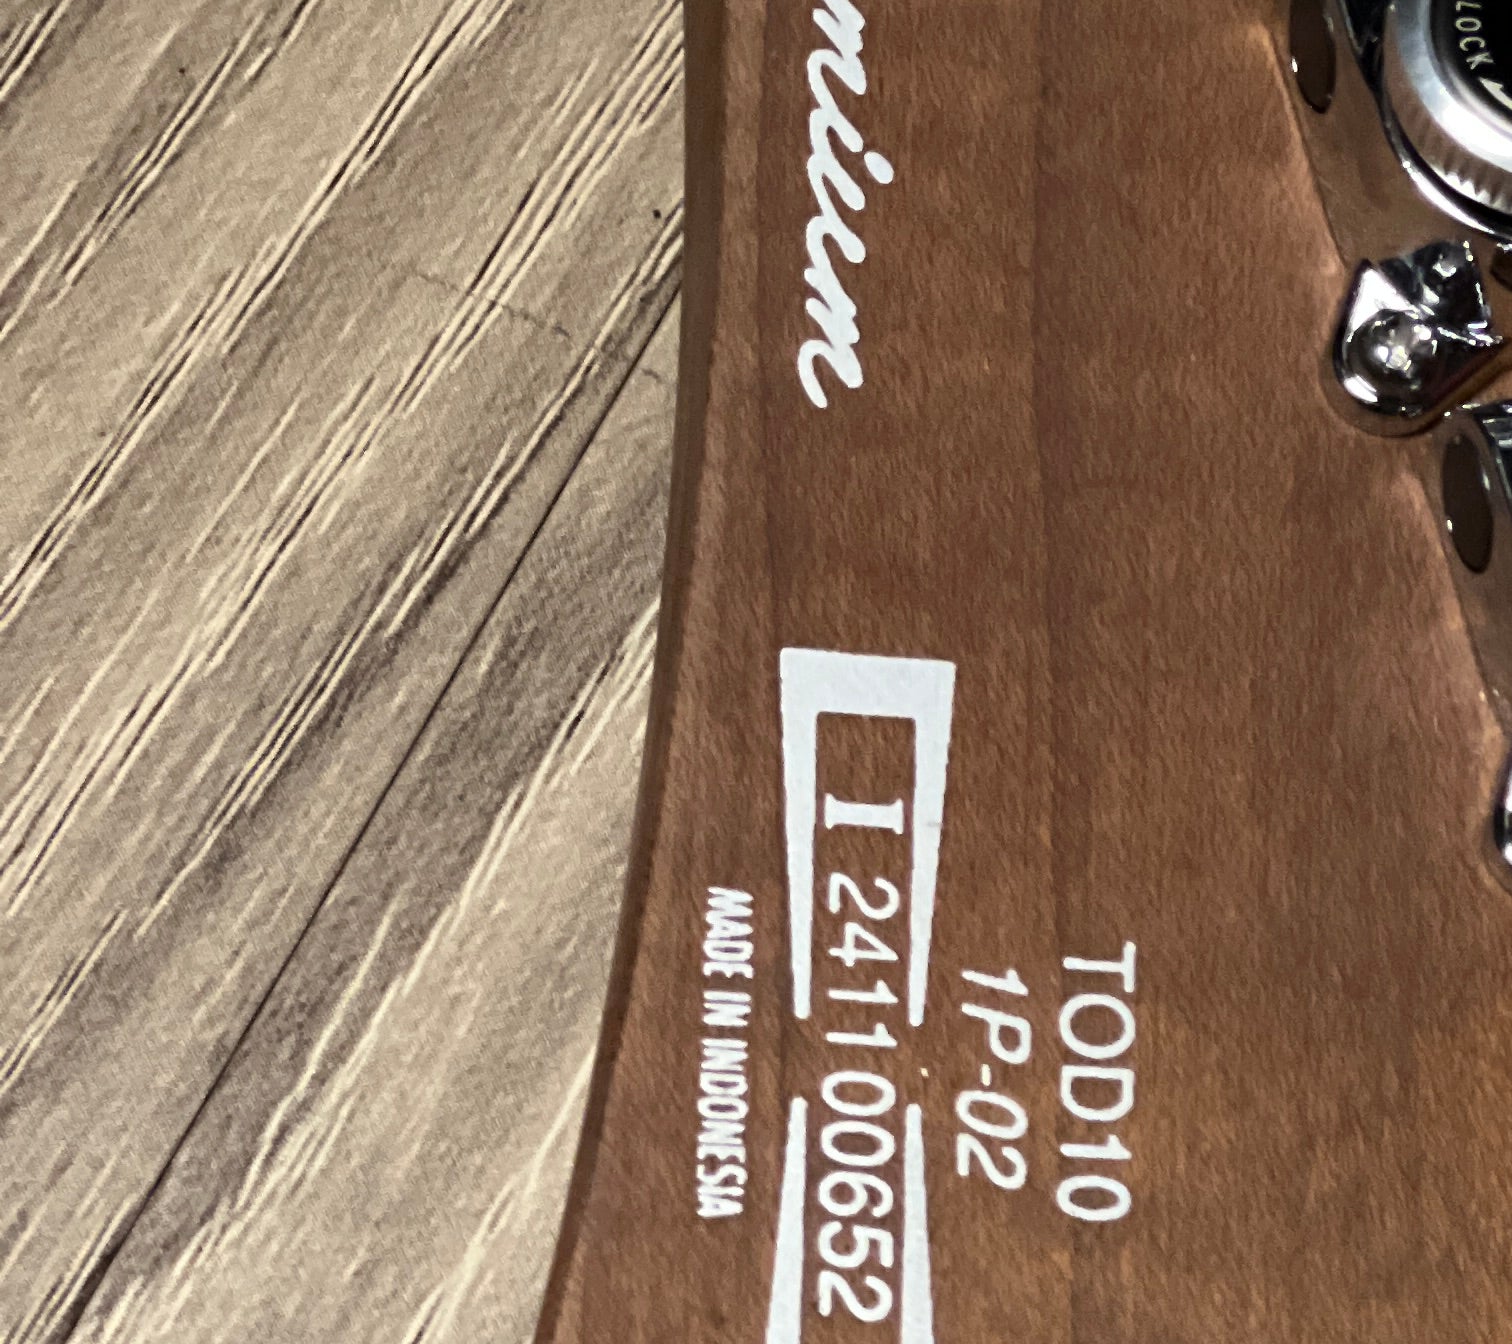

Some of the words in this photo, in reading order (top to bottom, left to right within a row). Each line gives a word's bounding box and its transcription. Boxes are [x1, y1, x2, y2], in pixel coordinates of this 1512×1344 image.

[1455, 0, 1495, 70] LOCK
[702, 885, 755, 981] MADE
[702, 990, 752, 1027] IN
[696, 1037, 749, 1219] INDONESIA
[816, 872, 901, 1324] 241100652
[954, 965, 1032, 1192] 1P-02
[1055, 940, 1137, 1223] TOD10
